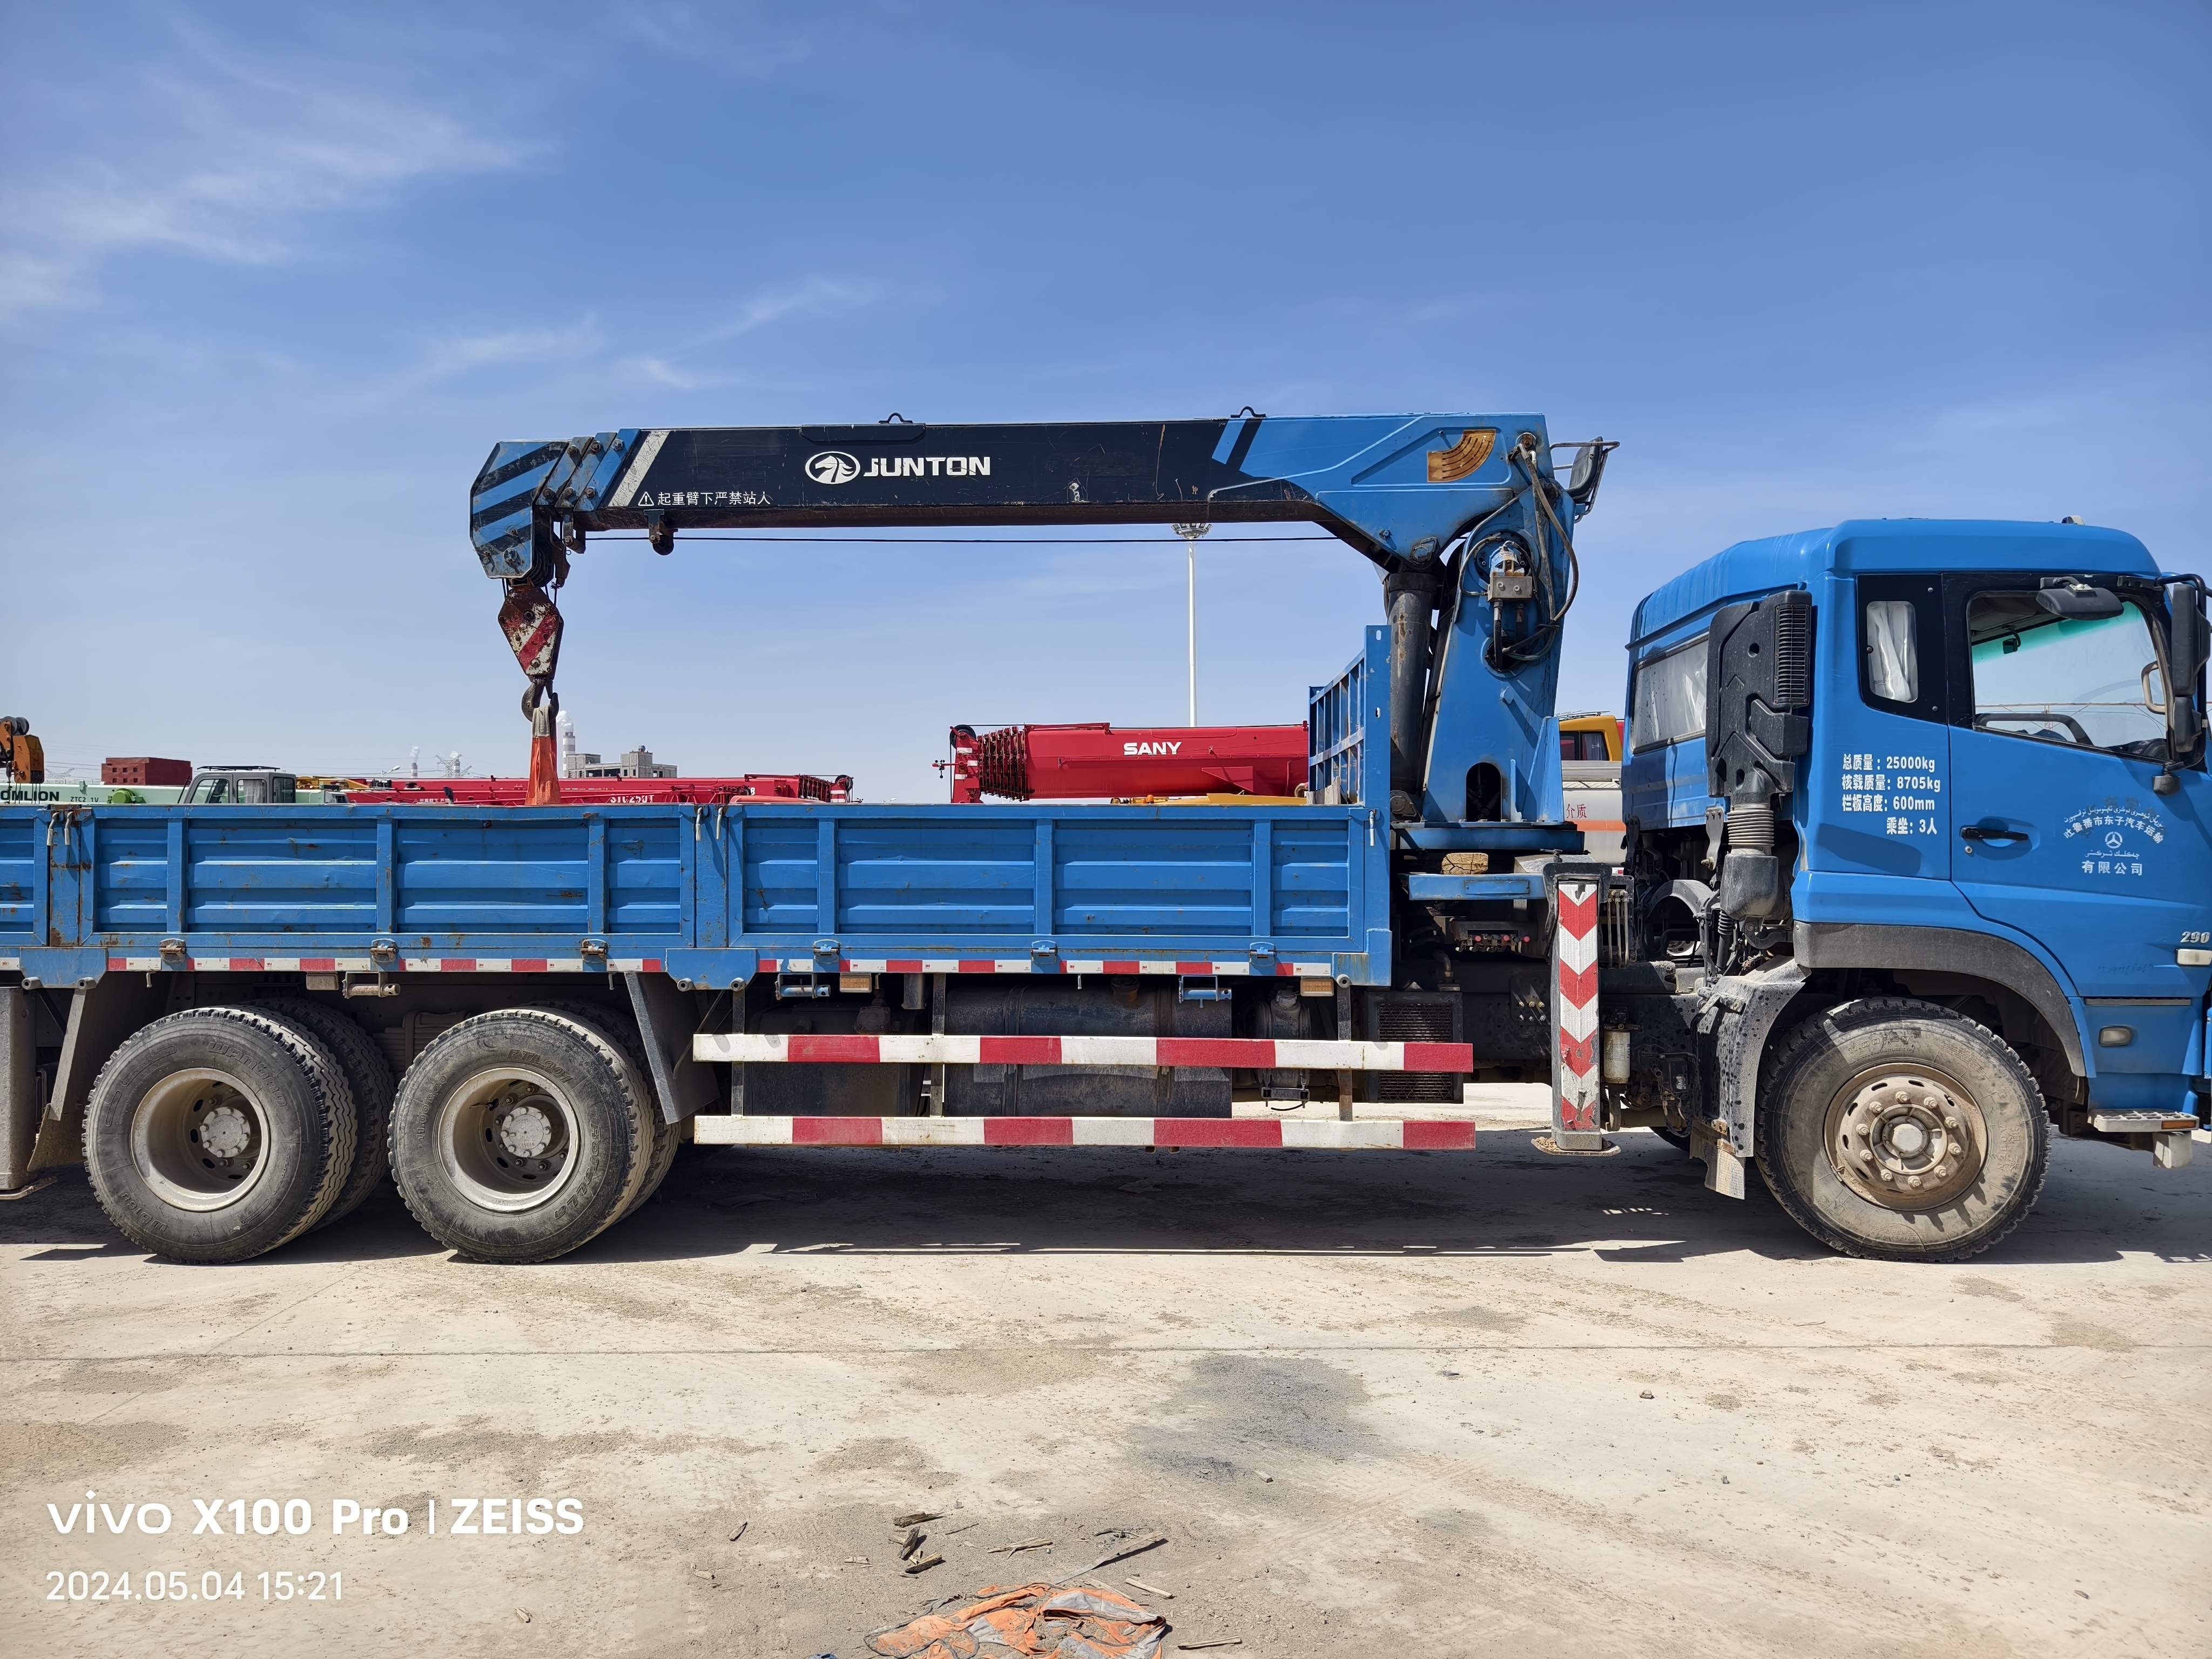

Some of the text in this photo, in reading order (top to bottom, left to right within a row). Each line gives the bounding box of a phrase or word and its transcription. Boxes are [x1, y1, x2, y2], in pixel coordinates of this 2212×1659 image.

[863, 456, 990, 477] JUNTON
[657, 491, 771, 506] 起重臂下严禁站人
[1123, 741, 1182, 756] SANY
[1886, 756, 1935, 773] 25000kg
[1897, 776, 1940, 792] 8705kg
[1893, 795, 1935, 811] 600mm
[1566, 804, 1587, 819] 介质
[1919, 817, 1937, 835] 3人
[2063, 815, 2164, 844] 吐鲁番市东子汽车运输
[2081, 860, 2143, 876] 有限公司
[2180, 931, 2210, 943] 290
